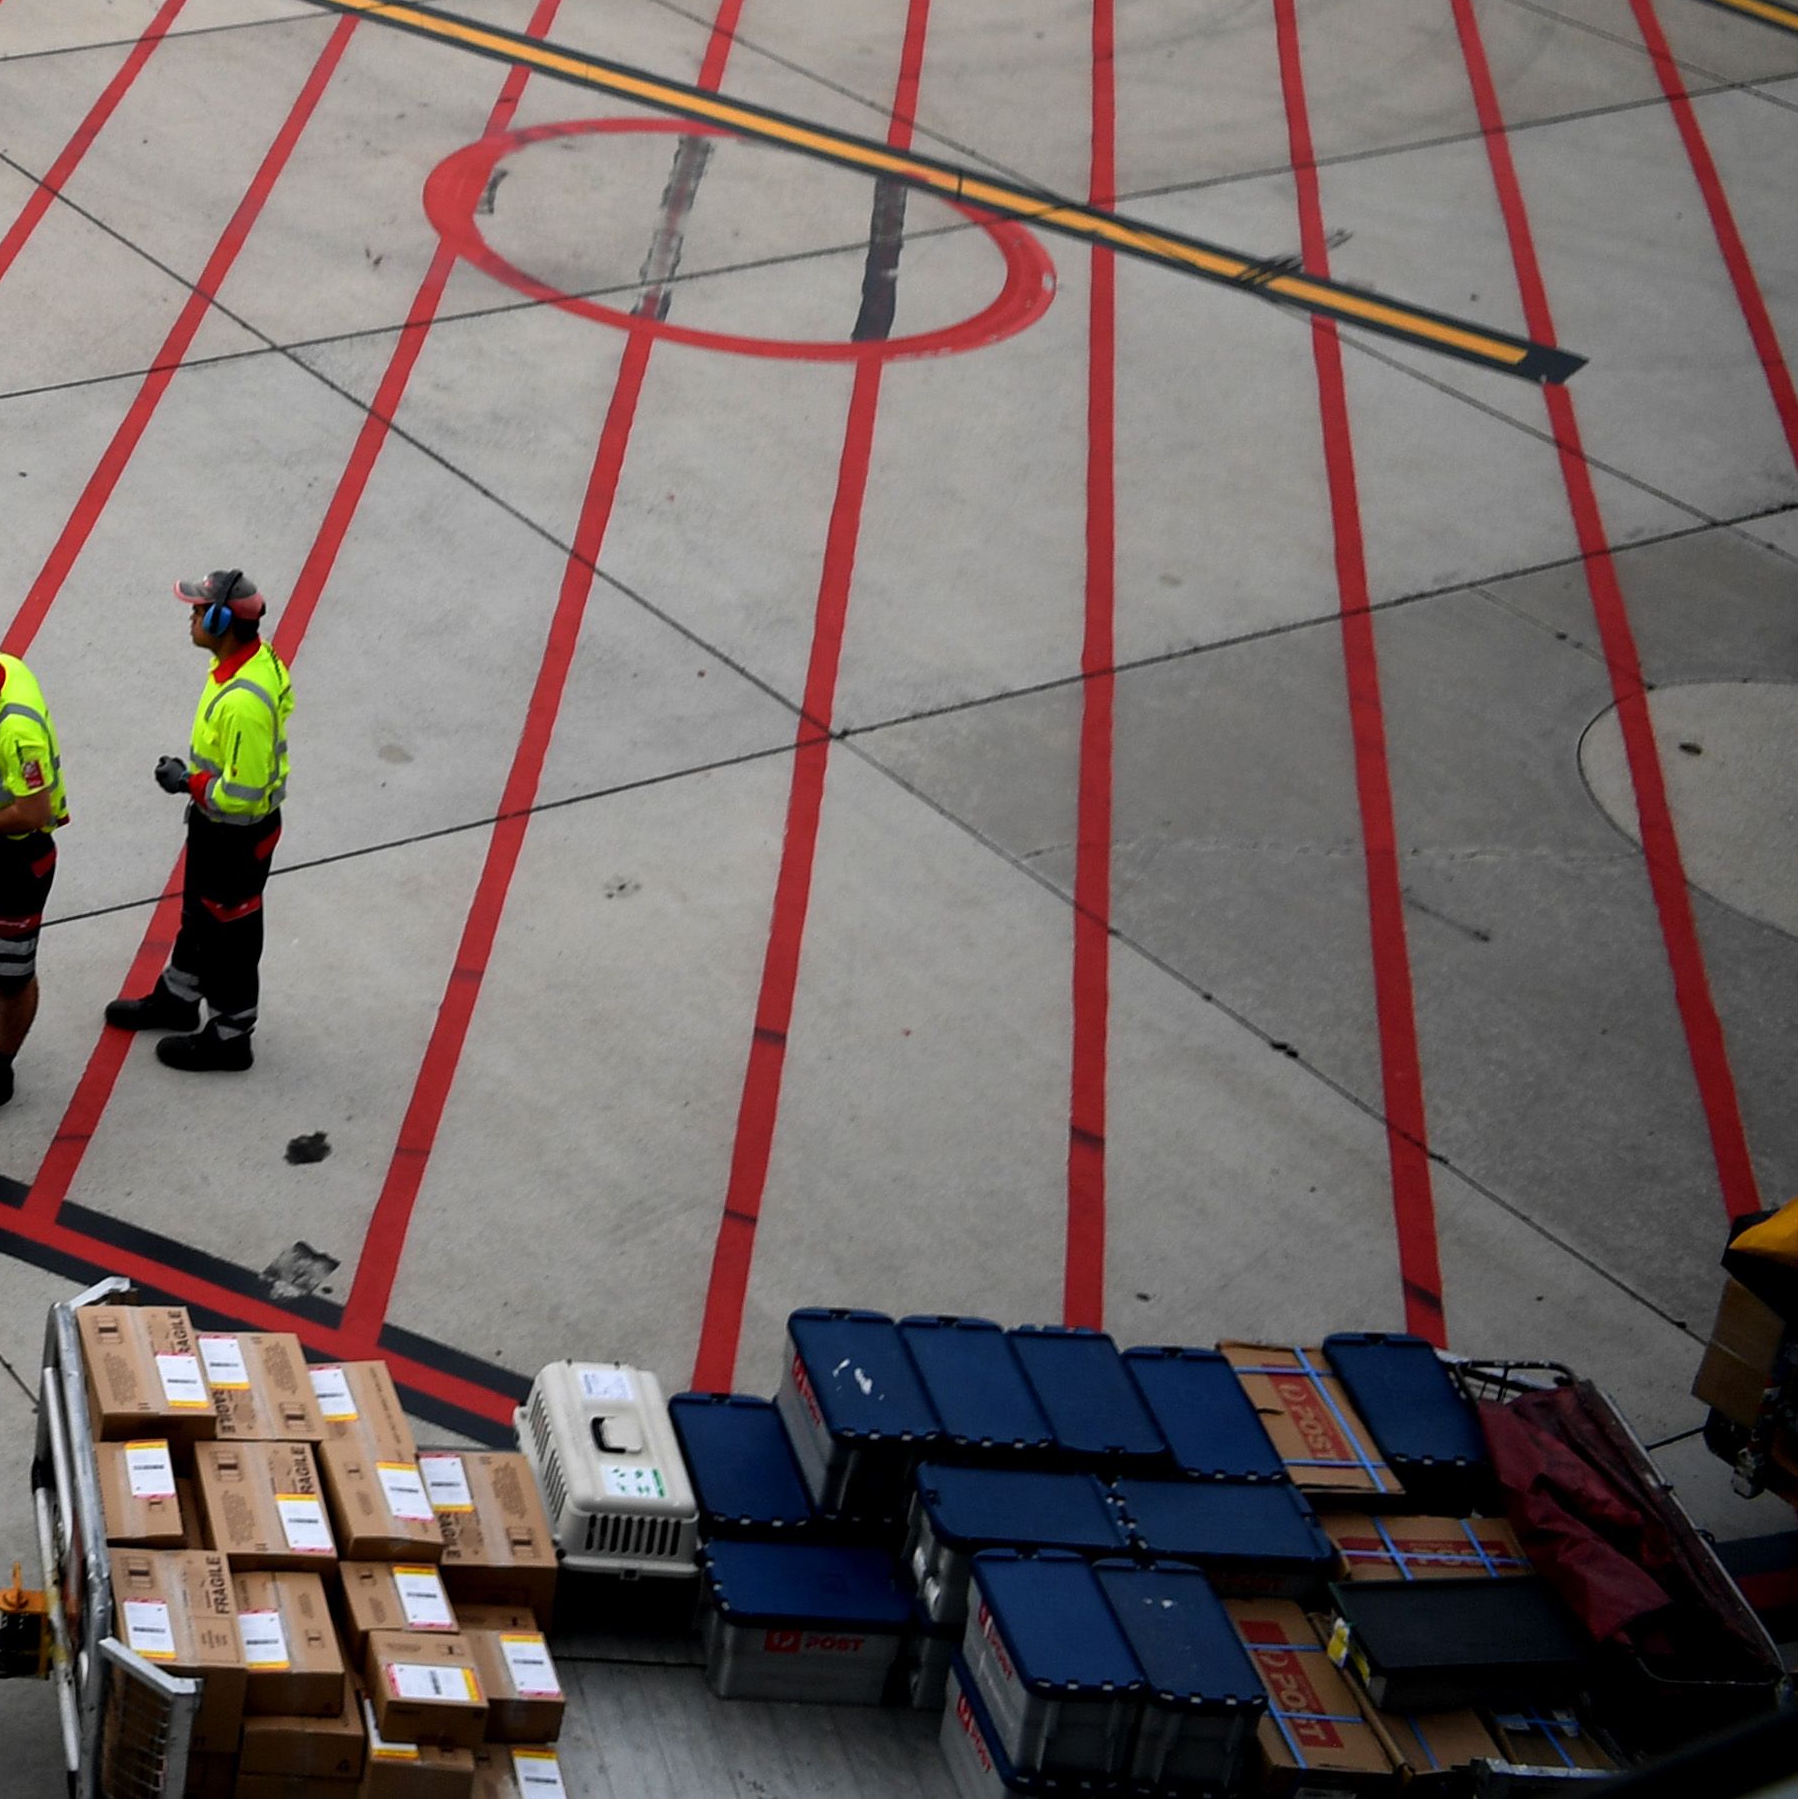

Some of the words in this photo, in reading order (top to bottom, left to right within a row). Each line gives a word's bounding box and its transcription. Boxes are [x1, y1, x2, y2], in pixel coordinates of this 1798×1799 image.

[167, 1310, 190, 1353] RAGILE
[291, 1446, 316, 1494] RAGILE
[206, 1555, 230, 1615] FRAGILE
